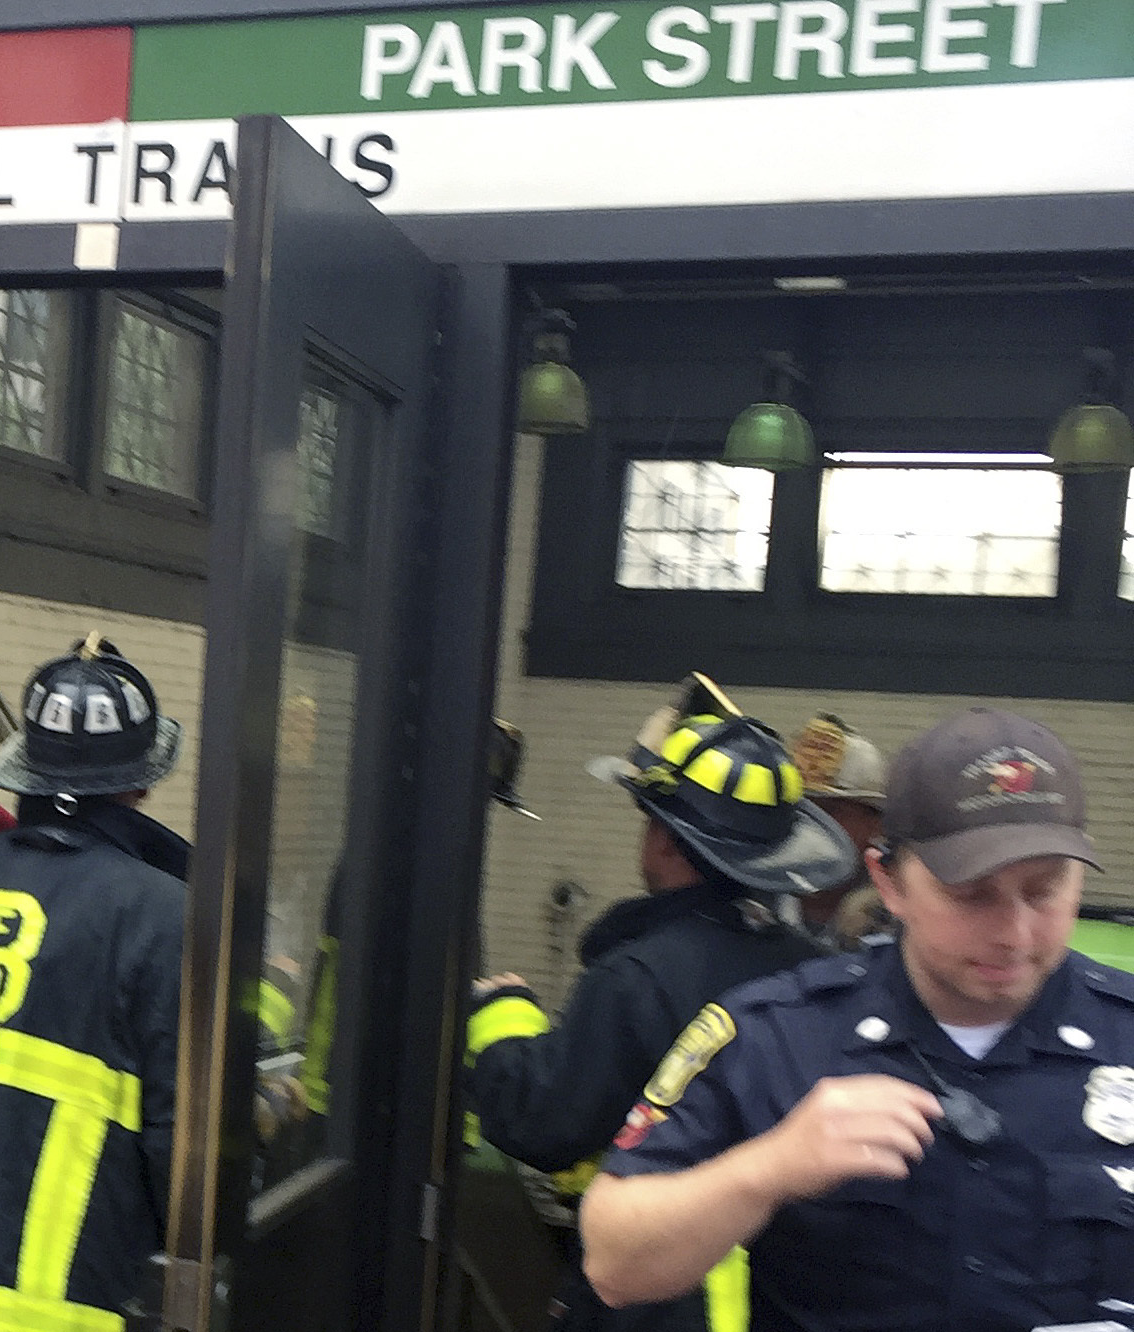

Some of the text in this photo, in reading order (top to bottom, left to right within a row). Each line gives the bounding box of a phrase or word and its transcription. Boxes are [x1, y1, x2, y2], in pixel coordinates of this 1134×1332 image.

[359, 0, 1068, 101] PARK STREET
[74, 132, 396, 206] TRAS
